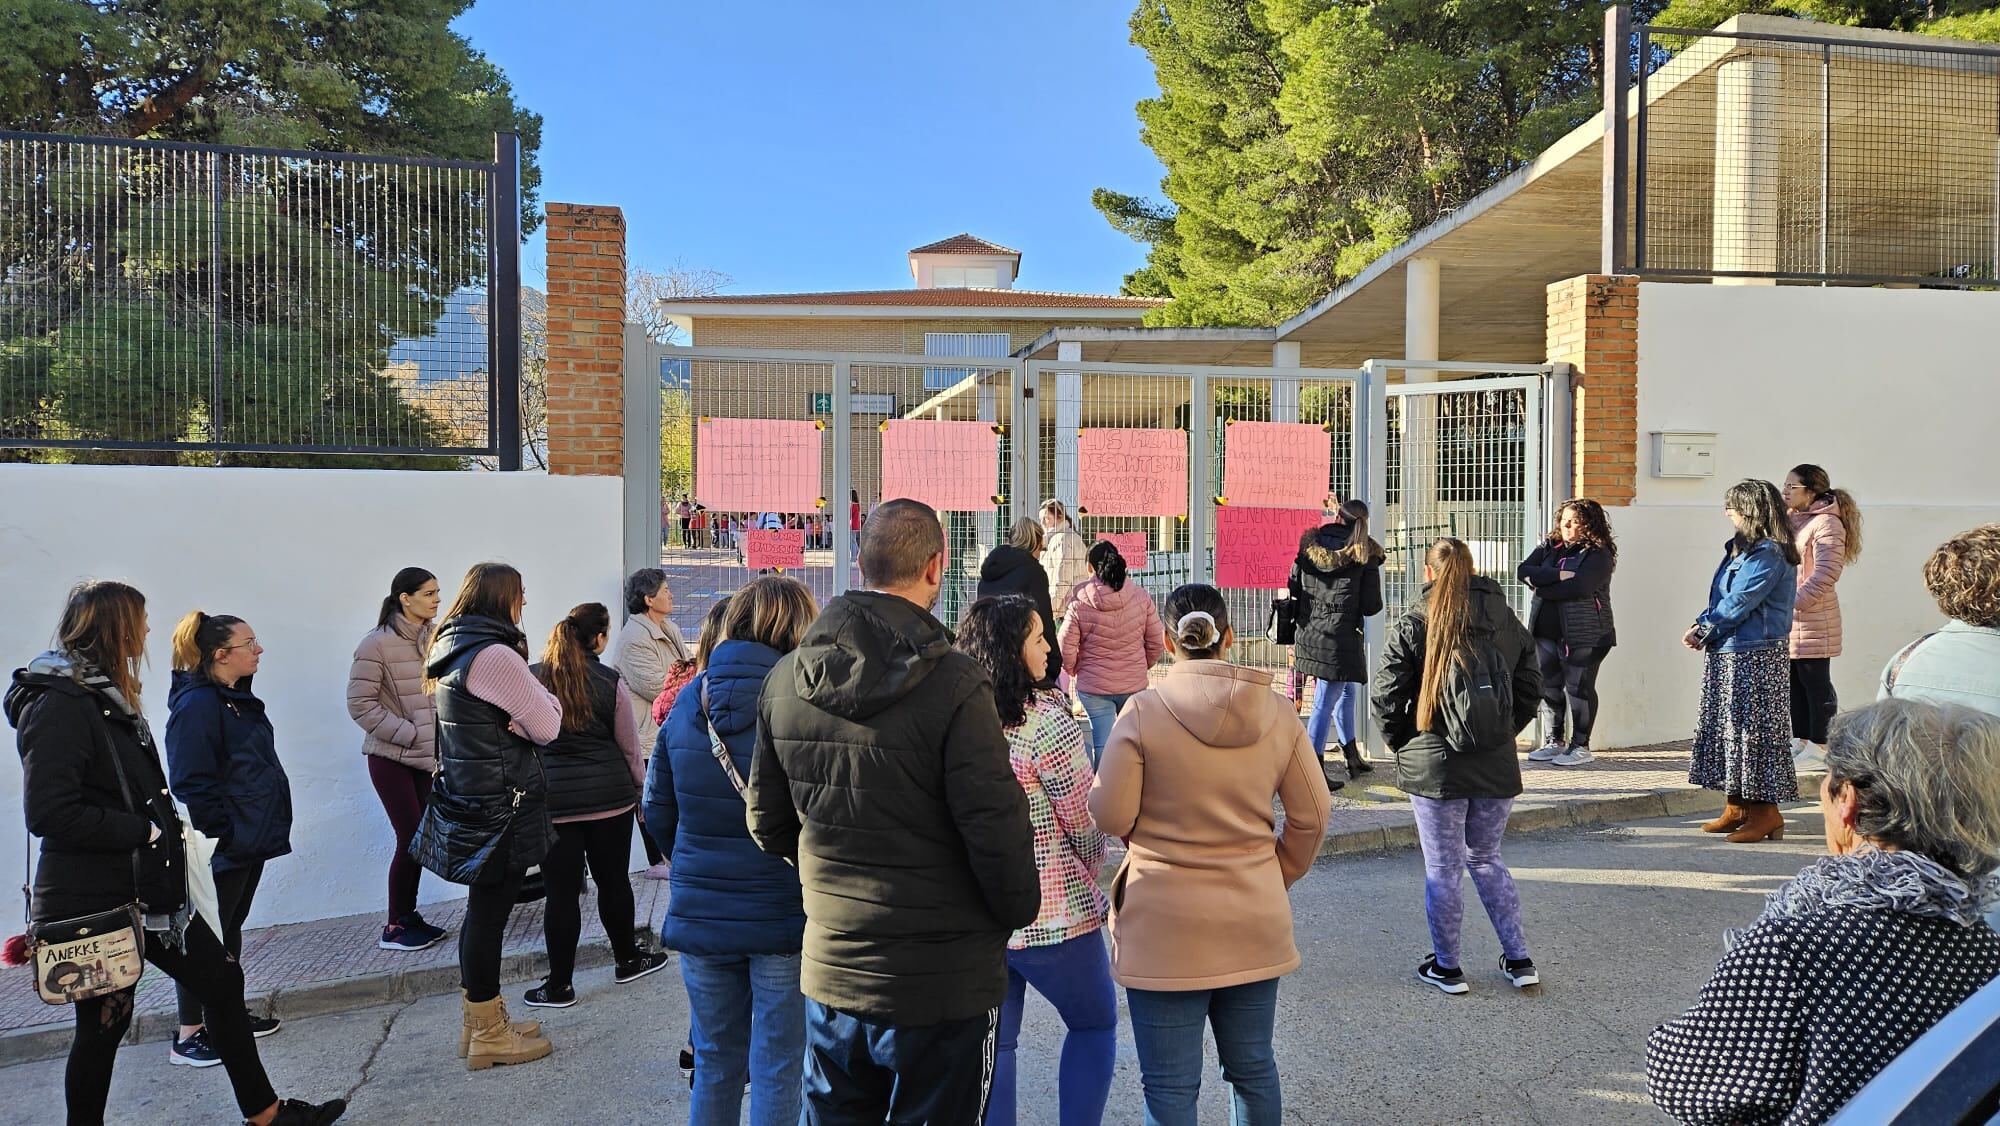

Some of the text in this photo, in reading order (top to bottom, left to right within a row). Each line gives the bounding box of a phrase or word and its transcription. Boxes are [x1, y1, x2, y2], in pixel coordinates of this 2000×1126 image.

[1081, 428, 1122, 450] LOS
[1084, 474, 1096, 490] Y
[1219, 528, 1239, 547] NO
[1241, 527, 1261, 546] ES
[1263, 528, 1283, 546] UN
[1219, 550, 1270, 564] ES UNA
[45, 940, 101, 964] ANEKKE
